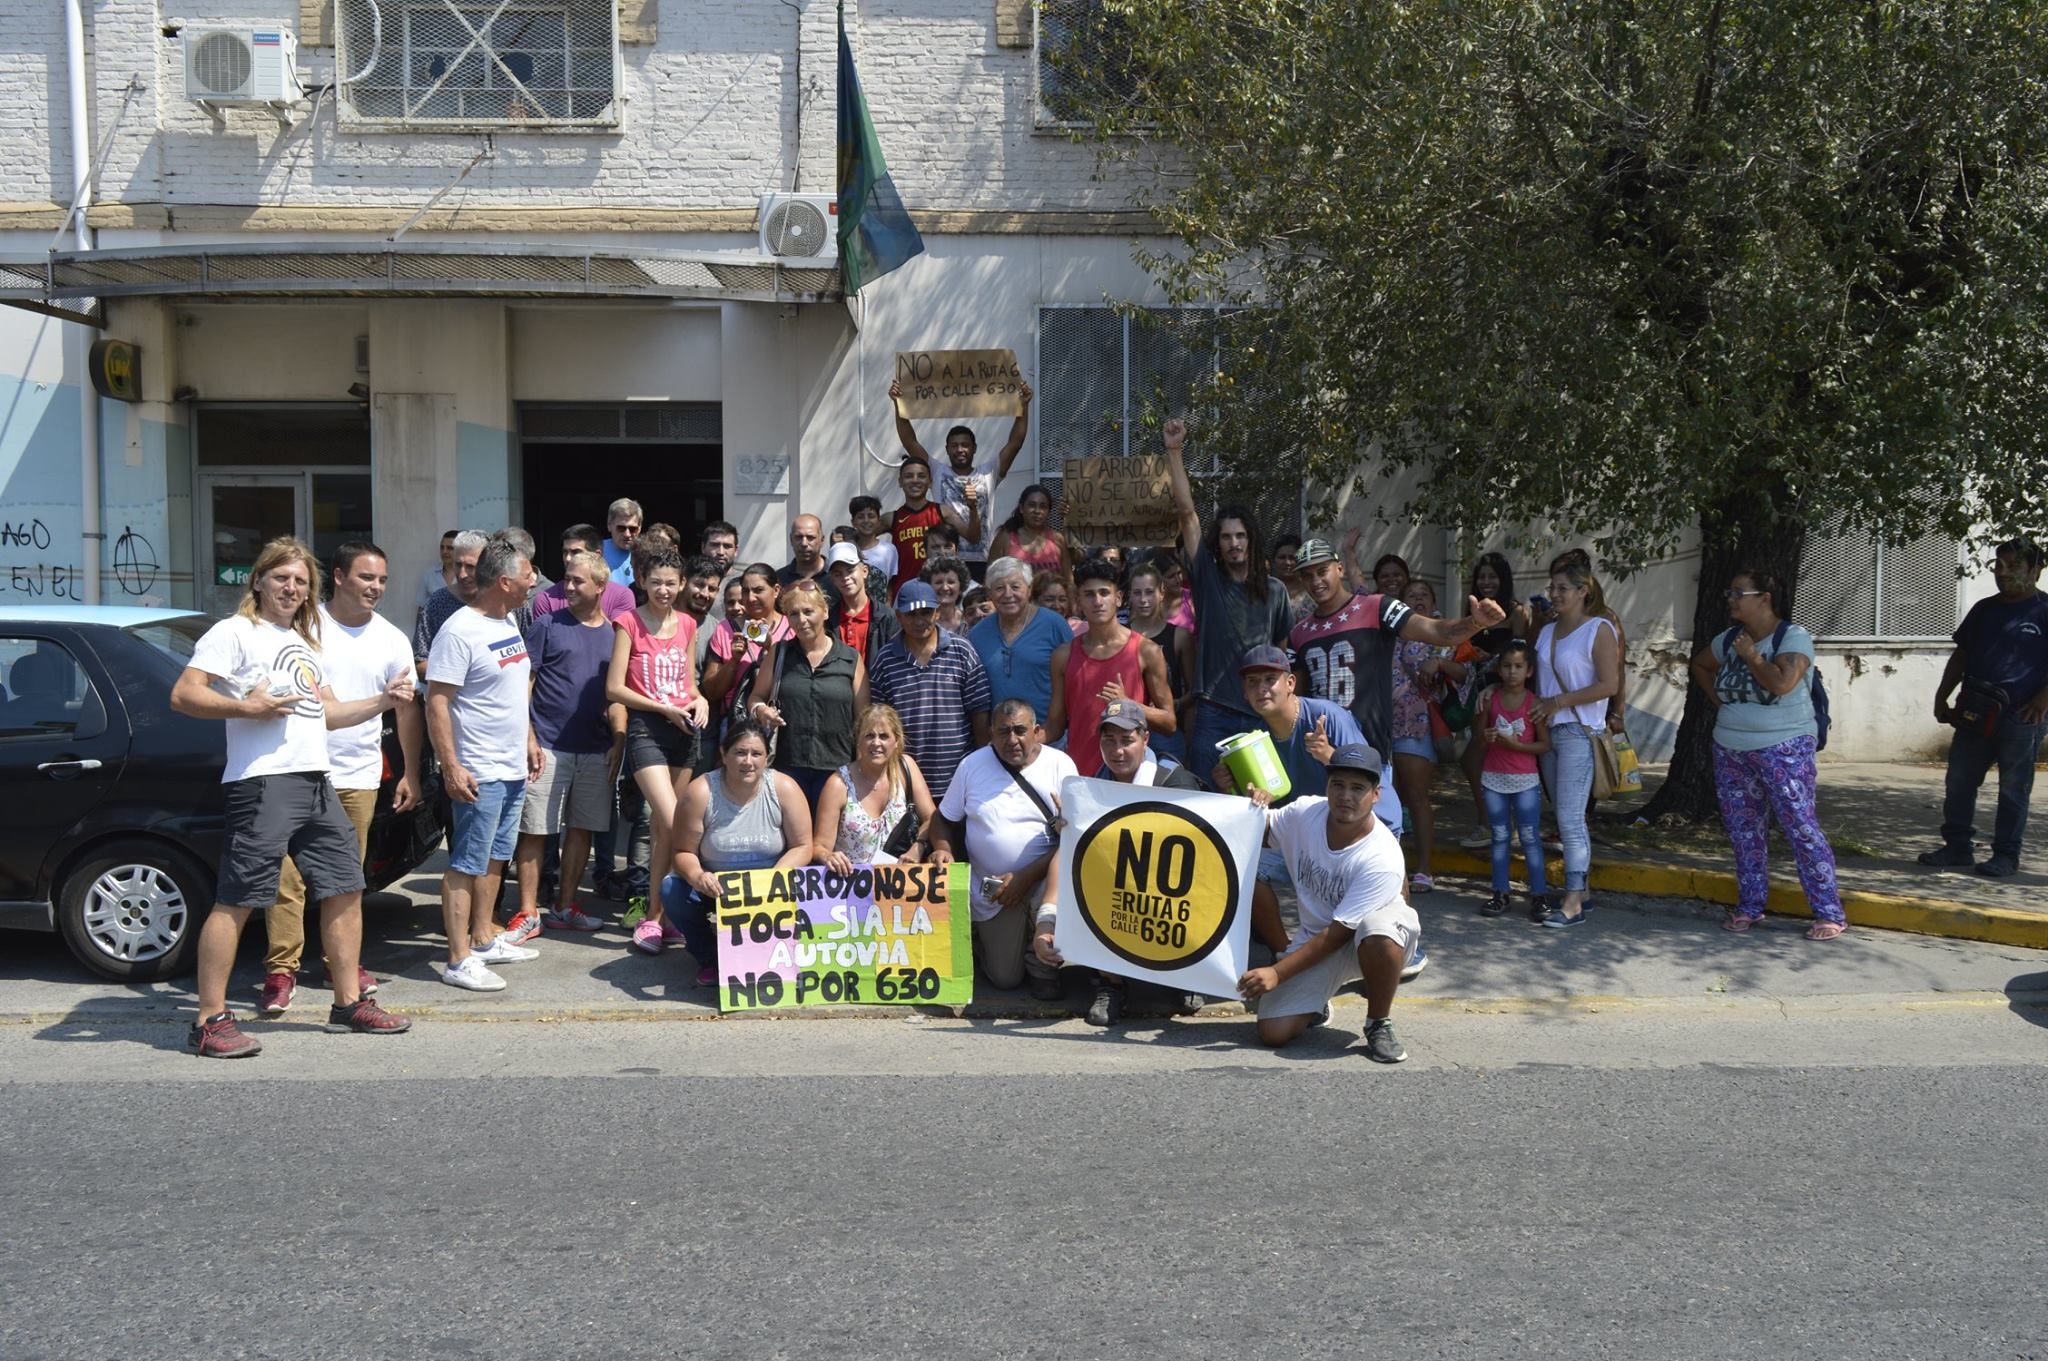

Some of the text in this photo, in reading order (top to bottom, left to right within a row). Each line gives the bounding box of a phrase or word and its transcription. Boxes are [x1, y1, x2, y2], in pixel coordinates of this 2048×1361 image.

[899, 354, 933, 381] NO
[942, 363, 953, 379] A
[959, 361, 974, 379] LA
[915, 382, 1016, 400] POR CALLE 630
[739, 459, 784, 474] 825
[1065, 457, 1165, 480] EL ARROYO
[1066, 480, 1175, 504] NO SE TOCA
[1, 518, 51, 550] AGO
[1067, 521, 1179, 545] NO POR 630
[236, 570, 250, 585] Fo
[1114, 828, 1196, 898] NO
[718, 872, 763, 909] EL
[1112, 911, 1139, 924] POR LA
[1123, 891, 1190, 922] RUTA 6
[827, 905, 859, 939] SI
[863, 905, 887, 936] A
[893, 905, 933, 935] LA
[1111, 920, 1139, 935] CALLE
[1140, 917, 1187, 948] 630
[769, 939, 910, 968] AUTOVIA
[728, 967, 940, 1007] NO POR 630
